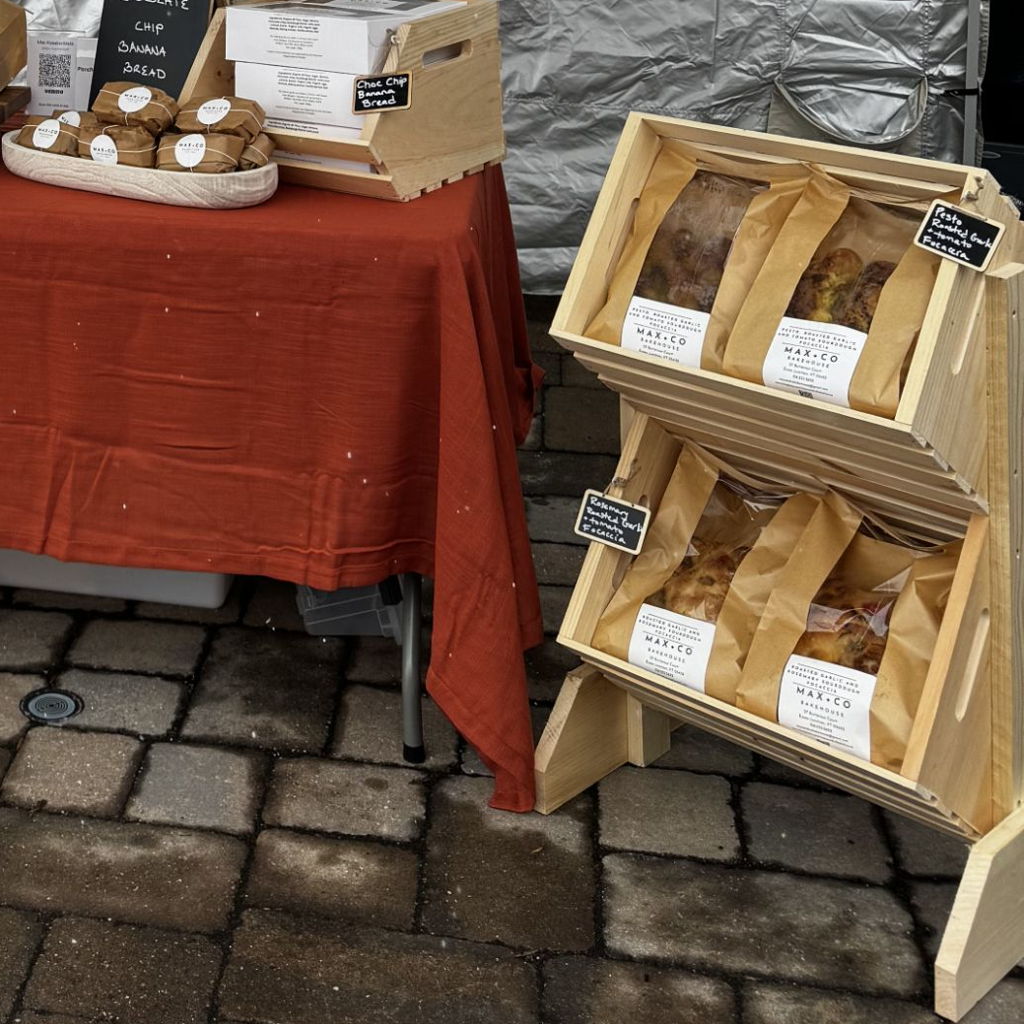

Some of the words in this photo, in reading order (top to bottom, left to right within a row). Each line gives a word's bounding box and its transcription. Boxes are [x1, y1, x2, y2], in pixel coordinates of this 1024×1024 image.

[135, 21, 164, 36] CHIP
[118, 40, 166, 57] BANANA
[123, 61, 166, 79] BREAD
[357, 80, 382, 89] Choc
[386, 76, 407, 88] Chip
[358, 89, 395, 99] Banana
[362, 95, 396, 108] Bread
[934, 206, 963, 226] Pesto
[932, 218, 968, 239] Roasted
[922, 235, 970, 261] Focaccia
[933, 230, 972, 248] tomato
[586, 506, 619, 524] Roasted
[590, 496, 629, 518] Rosemary
[582, 523, 627, 544] Focaccia
[589, 516, 624, 535] tomato
